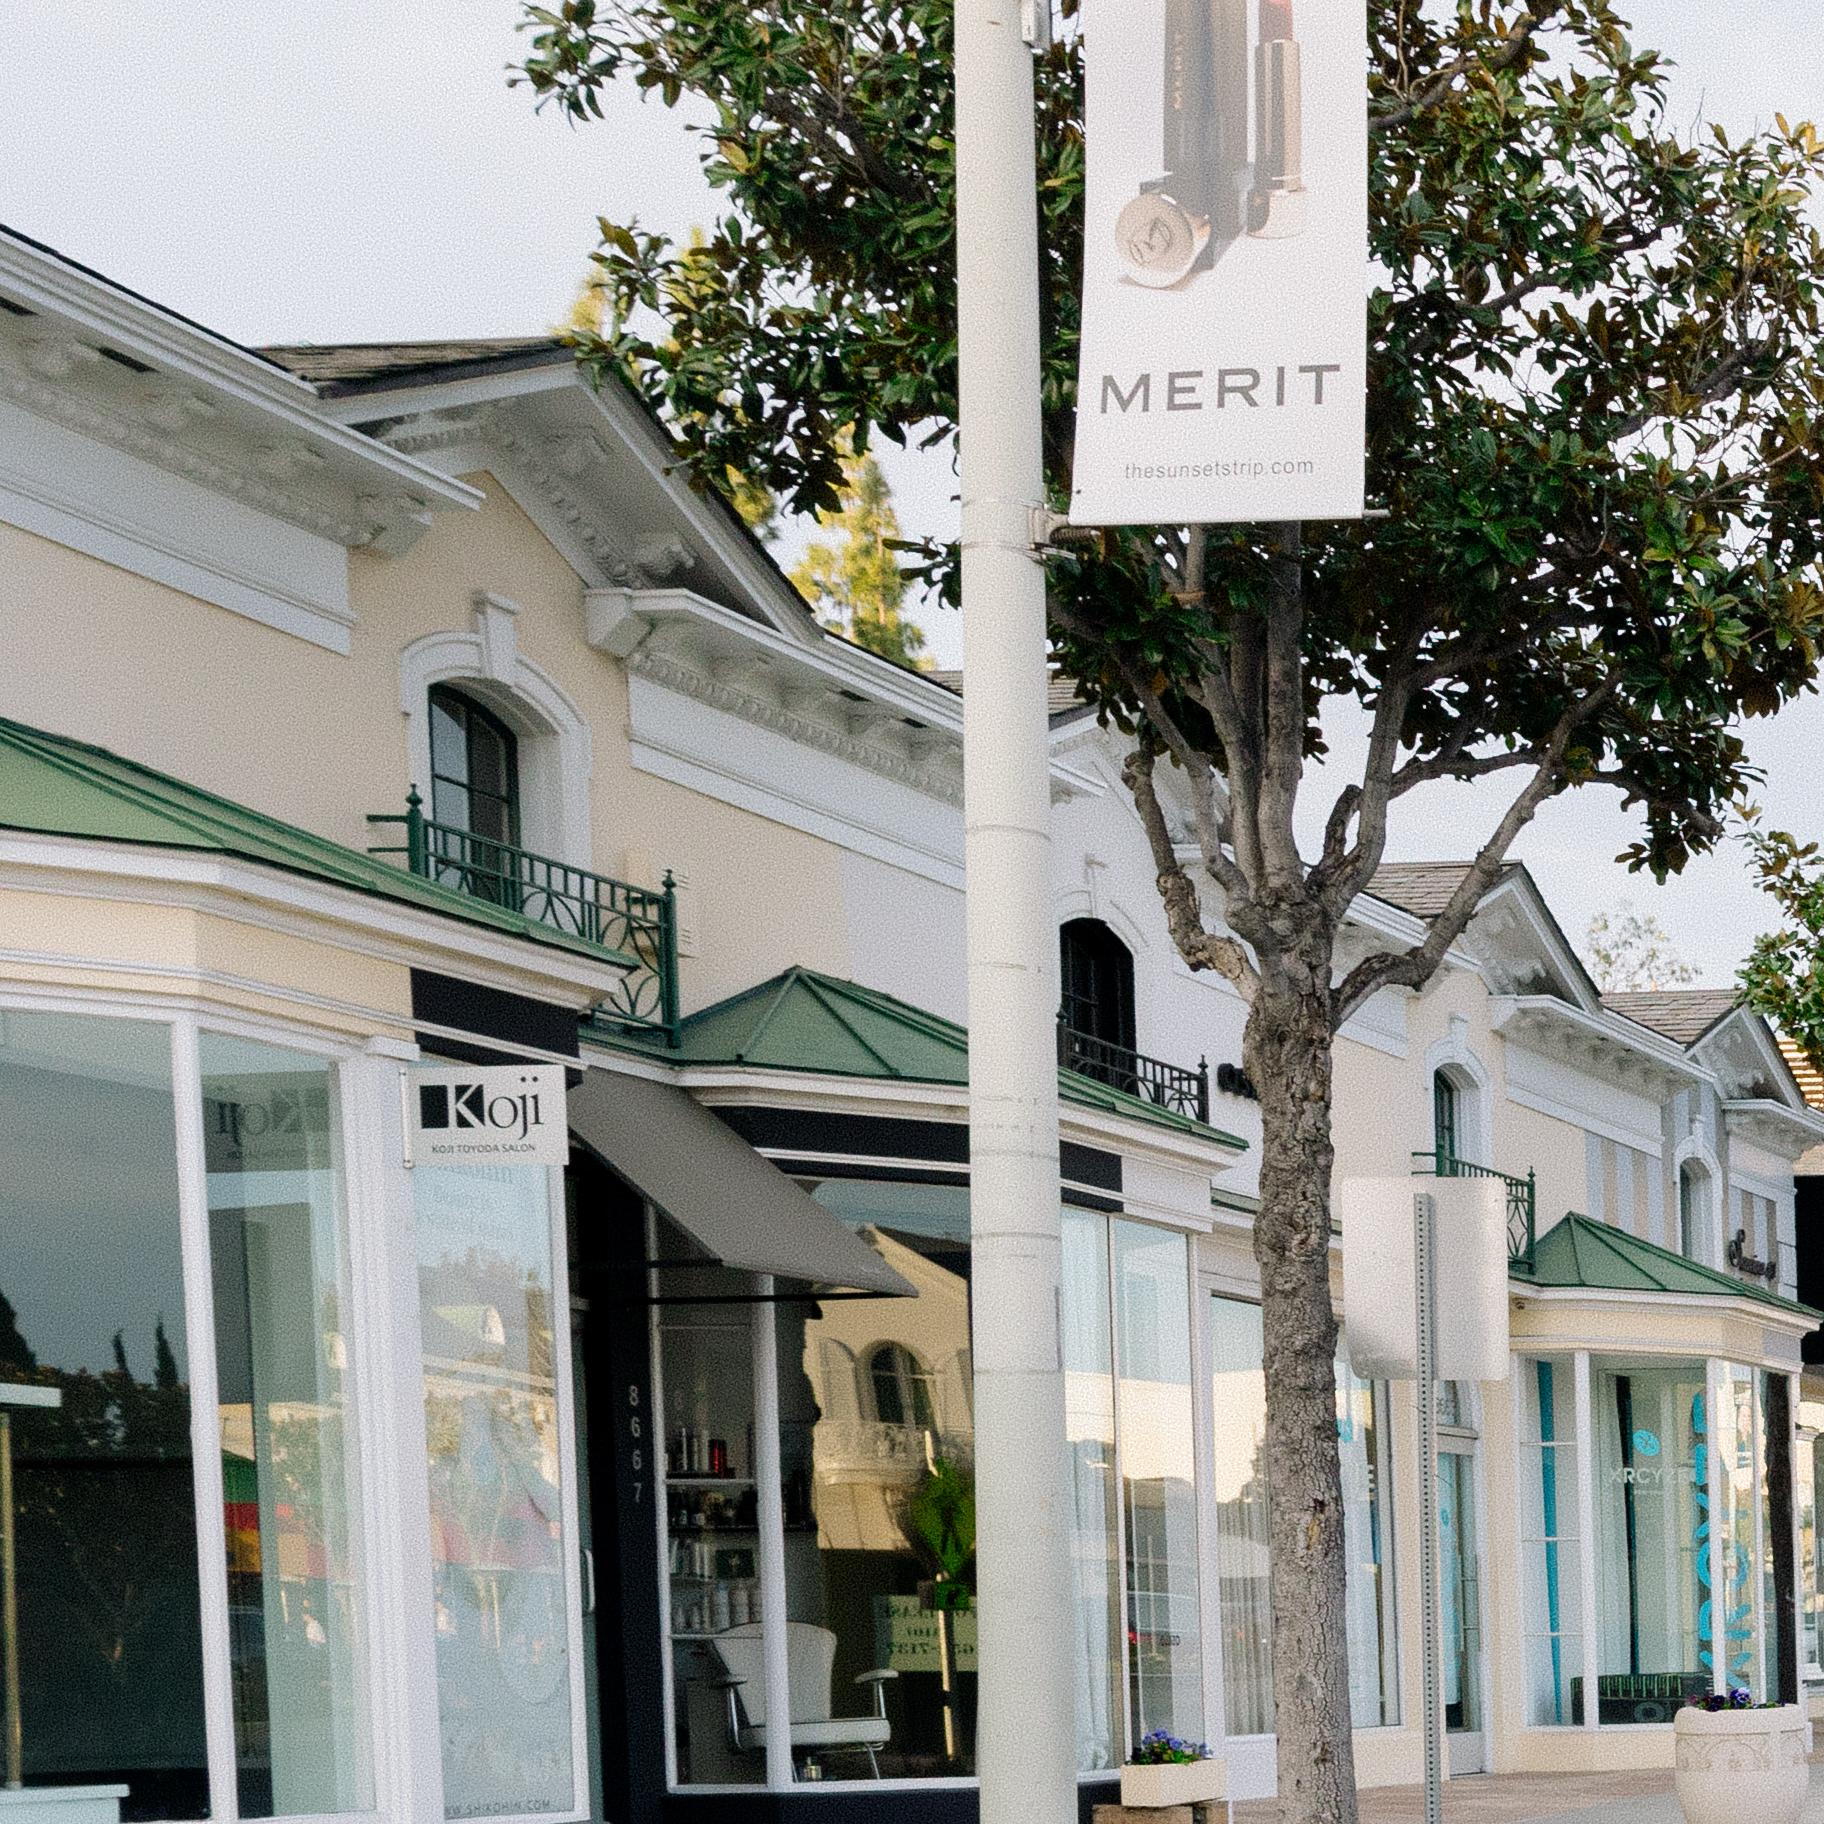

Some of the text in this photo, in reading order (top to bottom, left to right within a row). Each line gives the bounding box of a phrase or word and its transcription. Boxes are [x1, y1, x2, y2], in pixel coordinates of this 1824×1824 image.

[1100, 364, 1341, 414] MERIT
[1125, 459, 1314, 480] thesunsetstrip.com
[431, 1142, 537, 1154] KOJI TOYODA SALON
[628, 1384, 642, 1503] 8667
